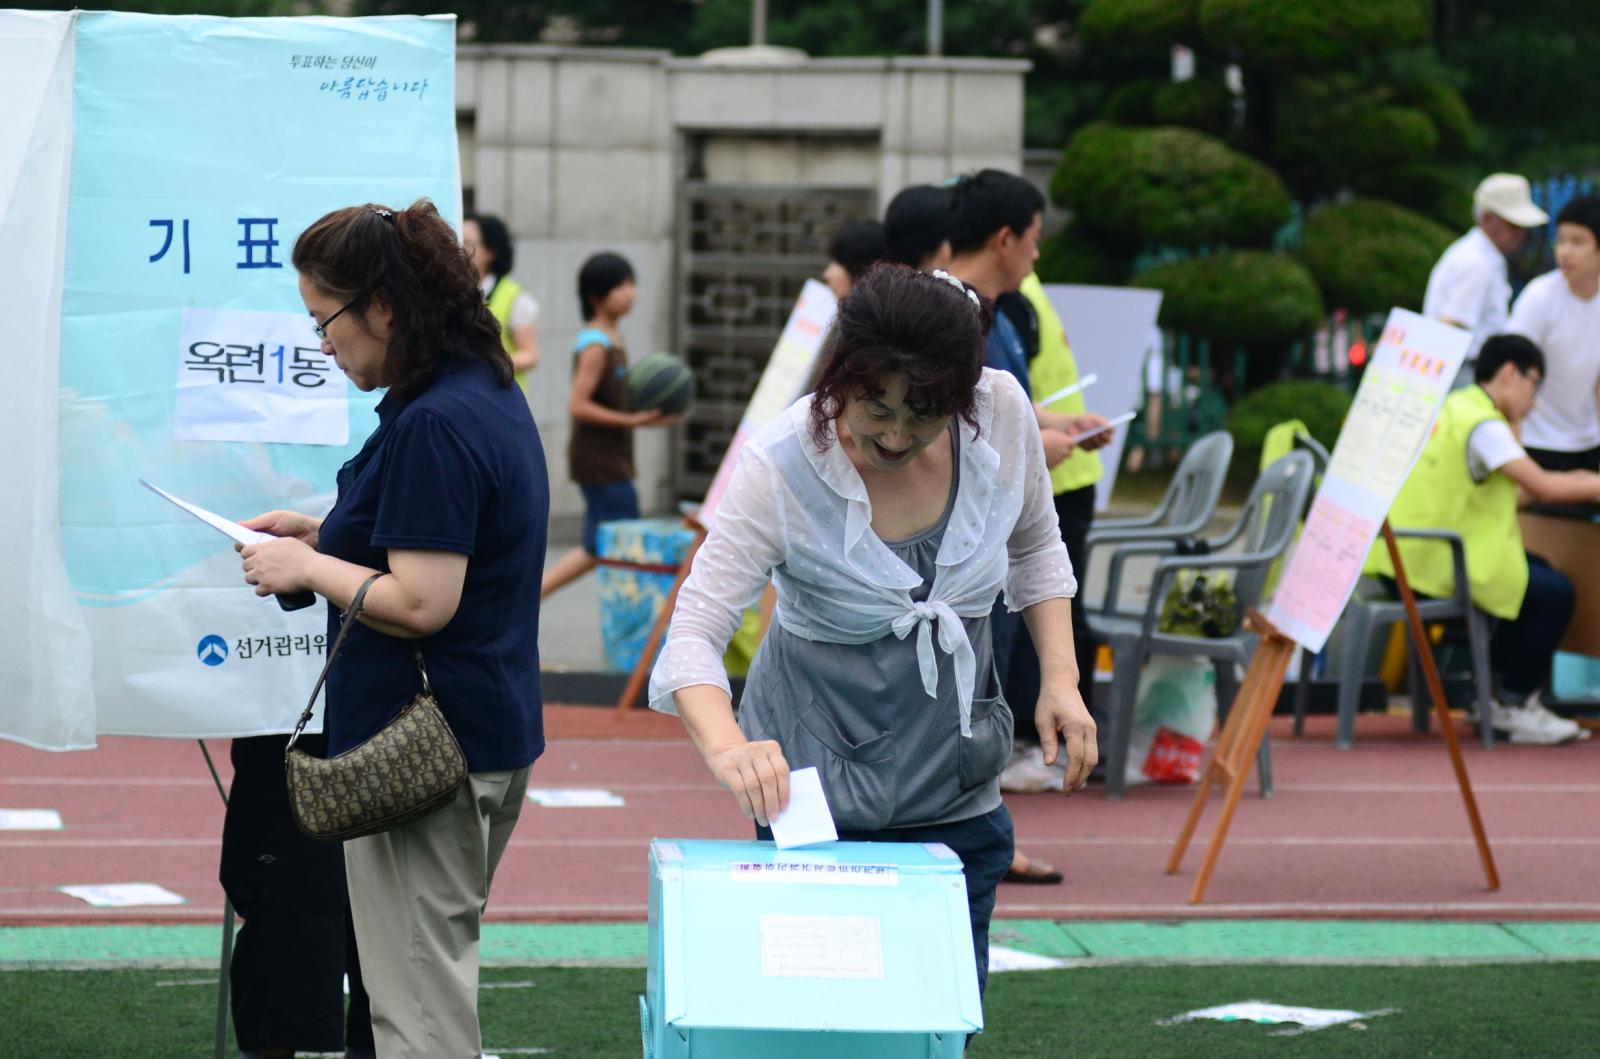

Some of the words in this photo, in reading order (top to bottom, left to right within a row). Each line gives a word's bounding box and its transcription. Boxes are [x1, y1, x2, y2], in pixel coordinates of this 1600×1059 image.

[289, 55, 337, 70] 투표하는
[340, 55, 378, 70] 당신이
[319, 76, 429, 101] 아름답습니다
[184, 341, 331, 388] 옥련1동
